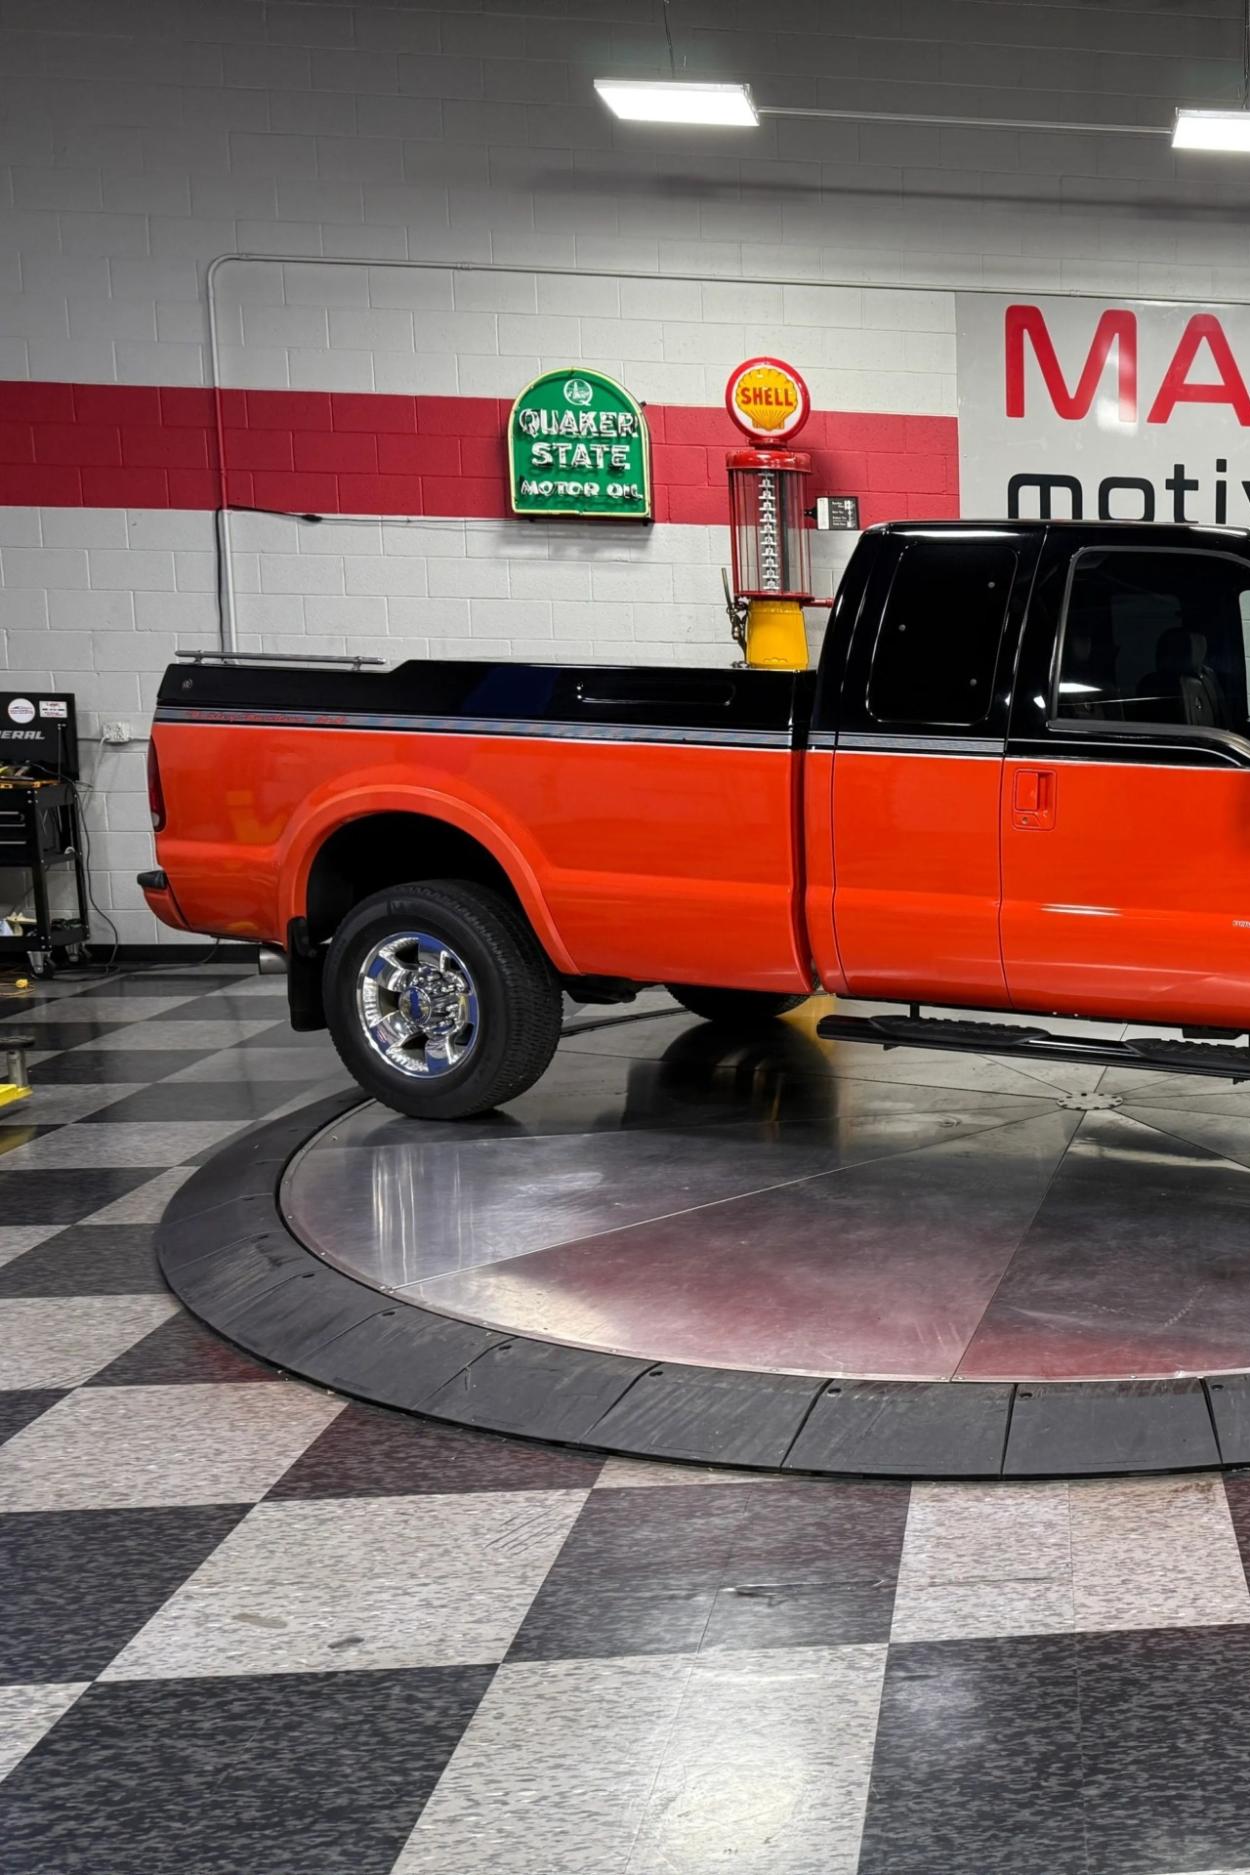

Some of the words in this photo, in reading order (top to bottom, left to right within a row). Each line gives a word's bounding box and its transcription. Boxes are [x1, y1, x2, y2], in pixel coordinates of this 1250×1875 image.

[740, 387, 793, 406] SHELL
[519, 408, 639, 438] QUAKER
[531, 442, 631, 470] STATE
[521, 480, 600, 497] MOTOR
[606, 482, 643, 499] OIL
[0, 730, 45, 740] ERAL
